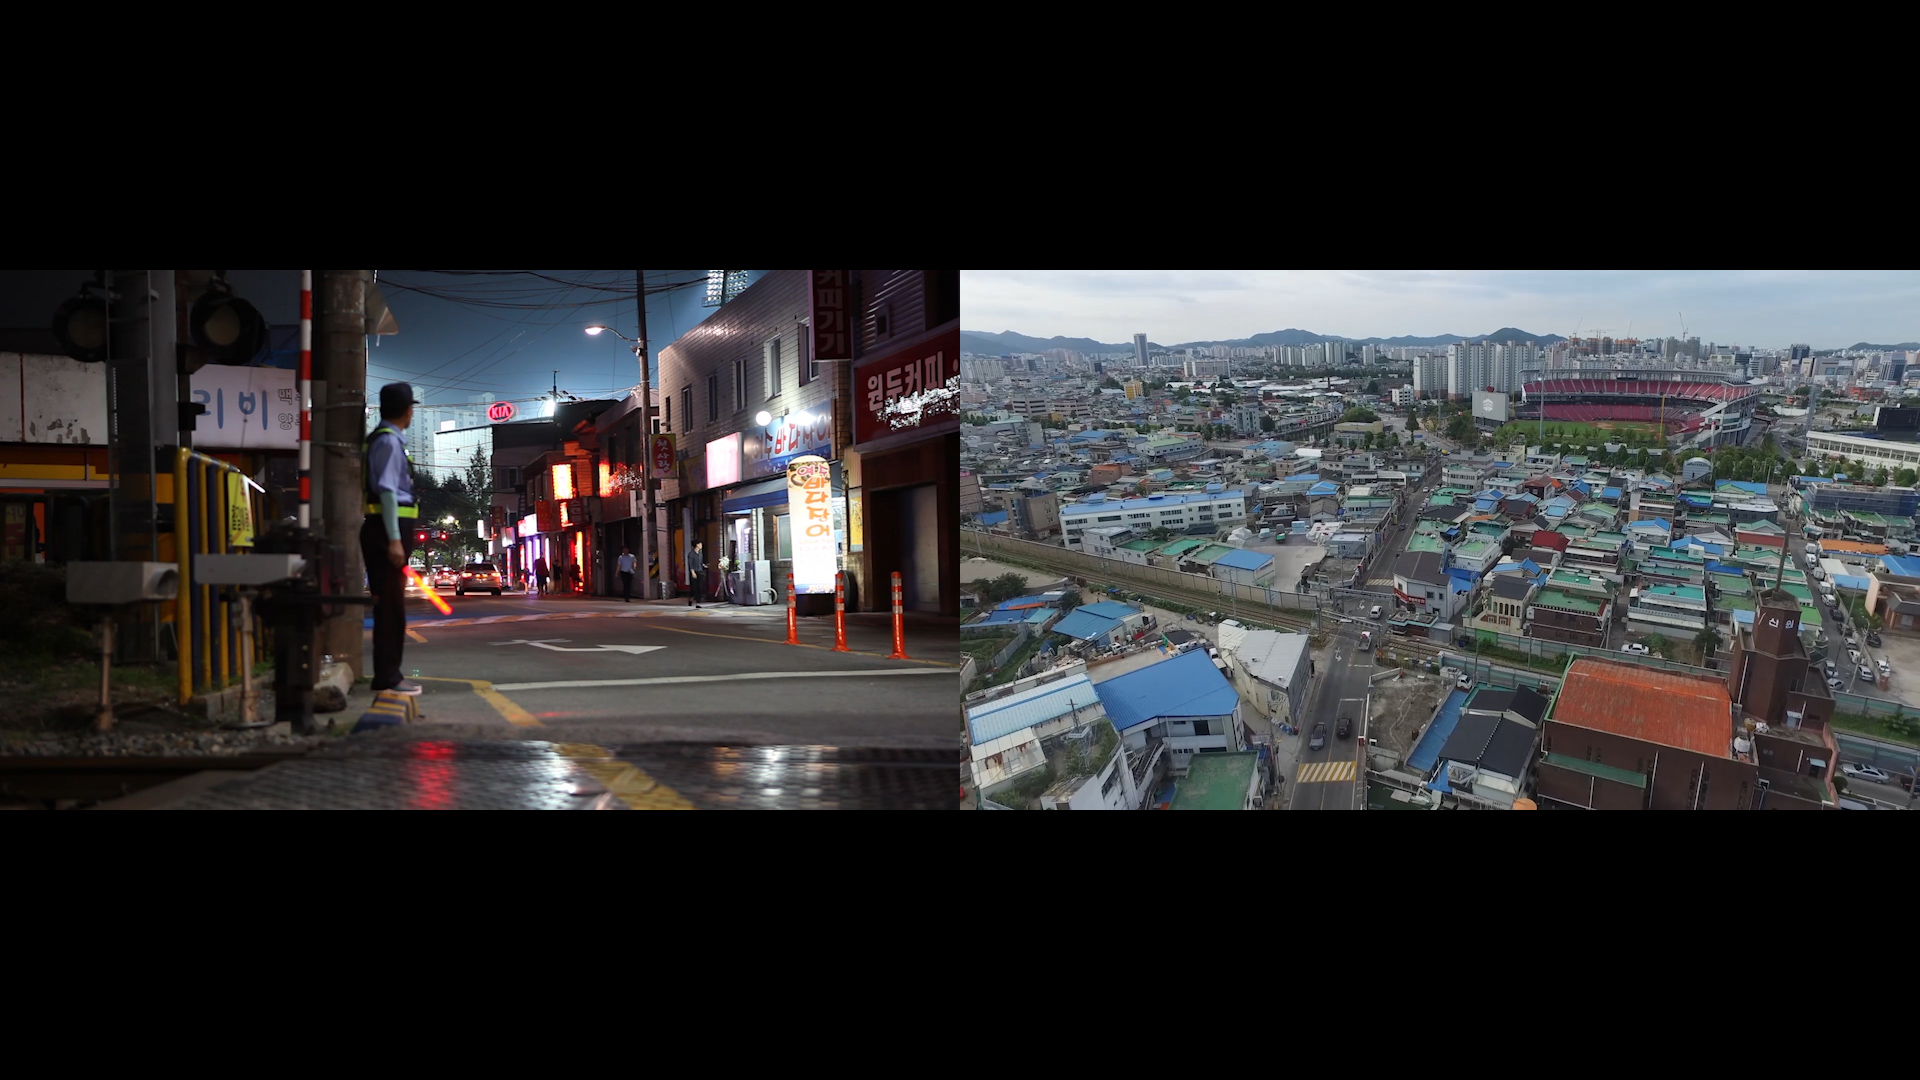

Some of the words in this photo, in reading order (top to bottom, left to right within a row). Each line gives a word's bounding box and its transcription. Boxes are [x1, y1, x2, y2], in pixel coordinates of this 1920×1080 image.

[867, 350, 944, 412] 원두커피
[656, 439, 670, 471] 첫사랑
[796, 464, 829, 477] 여수
[803, 477, 830, 537] 바다장어
